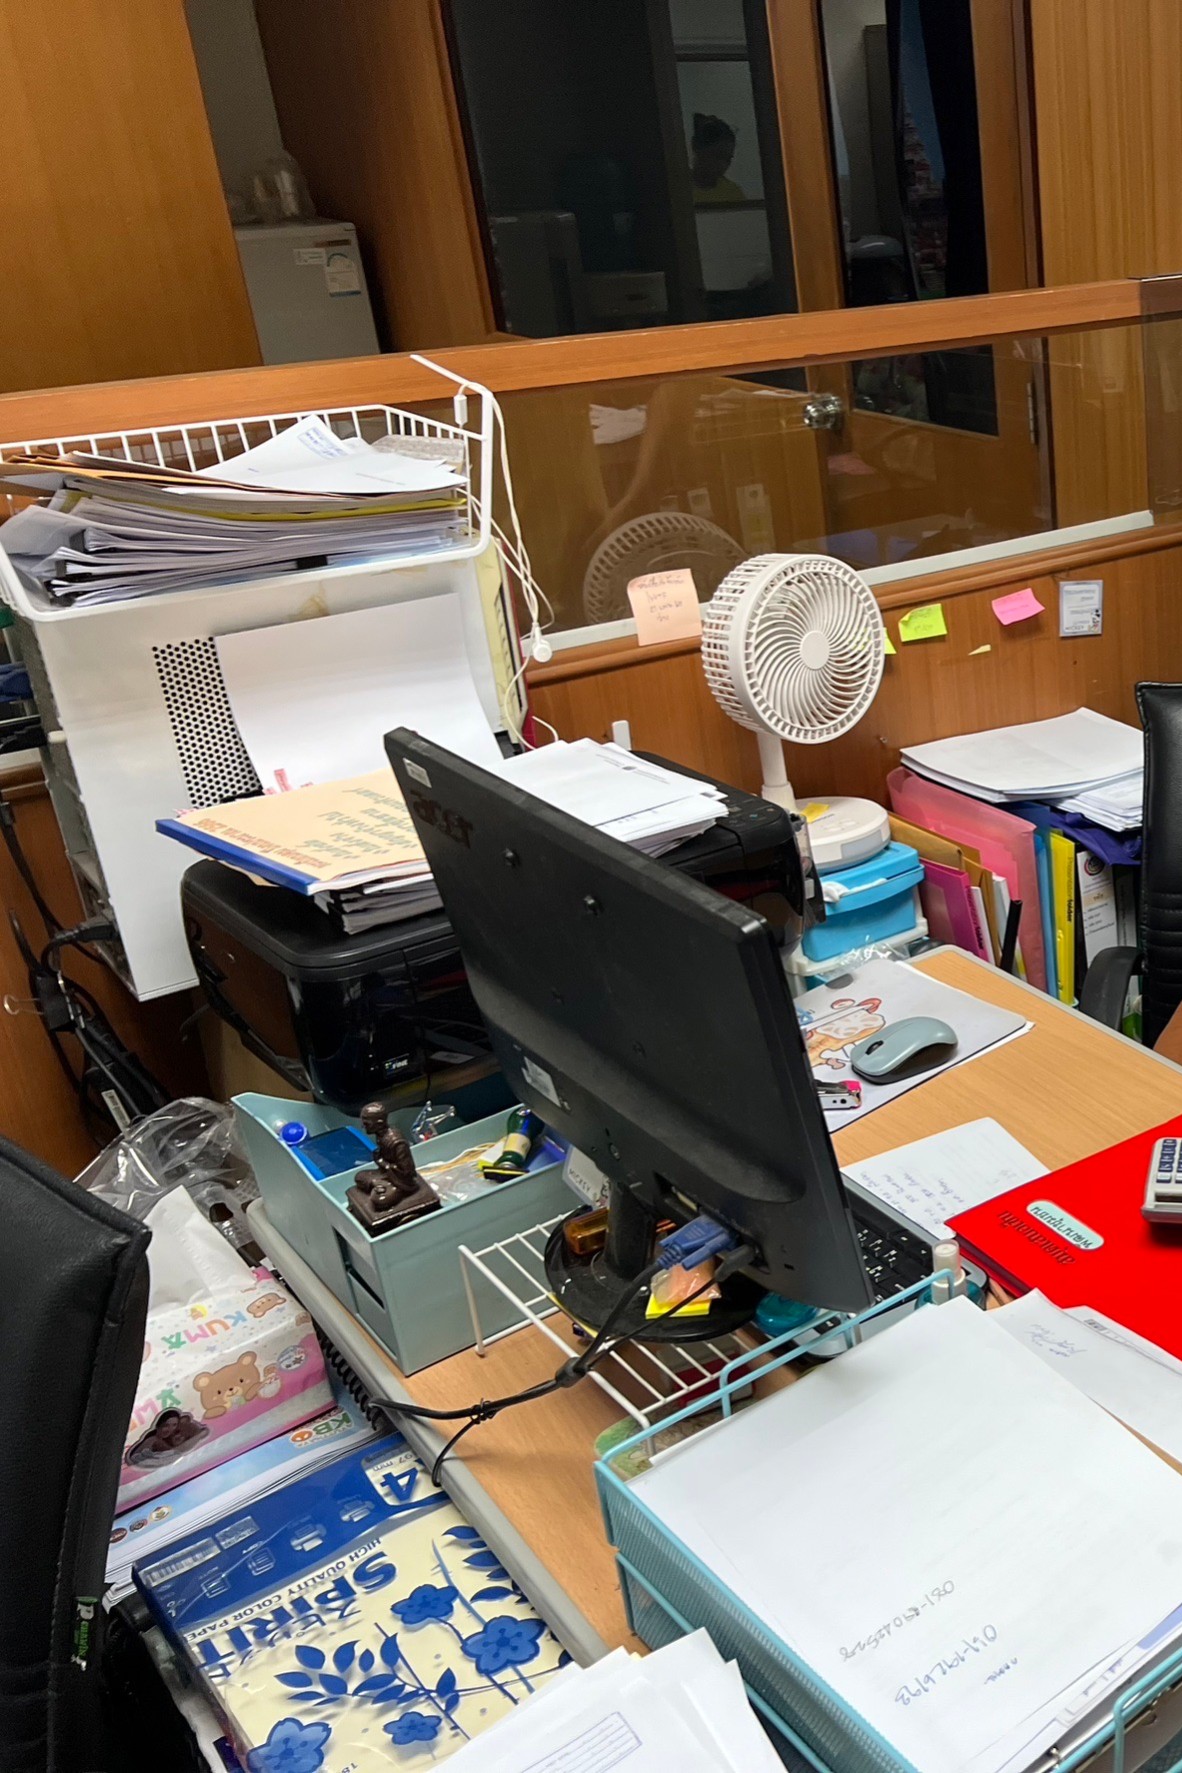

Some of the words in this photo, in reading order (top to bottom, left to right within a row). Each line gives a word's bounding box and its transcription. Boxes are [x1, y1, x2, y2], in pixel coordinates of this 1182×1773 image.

[161, 1308, 249, 1352] KUMA
[380, 1457, 427, 1503] 4
[349, 1537, 382, 1563] HIGH
[287, 1560, 347, 1597] QUALITY
[197, 1550, 398, 1668] SPIRIT
[233, 1593, 283, 1622] COLOR
